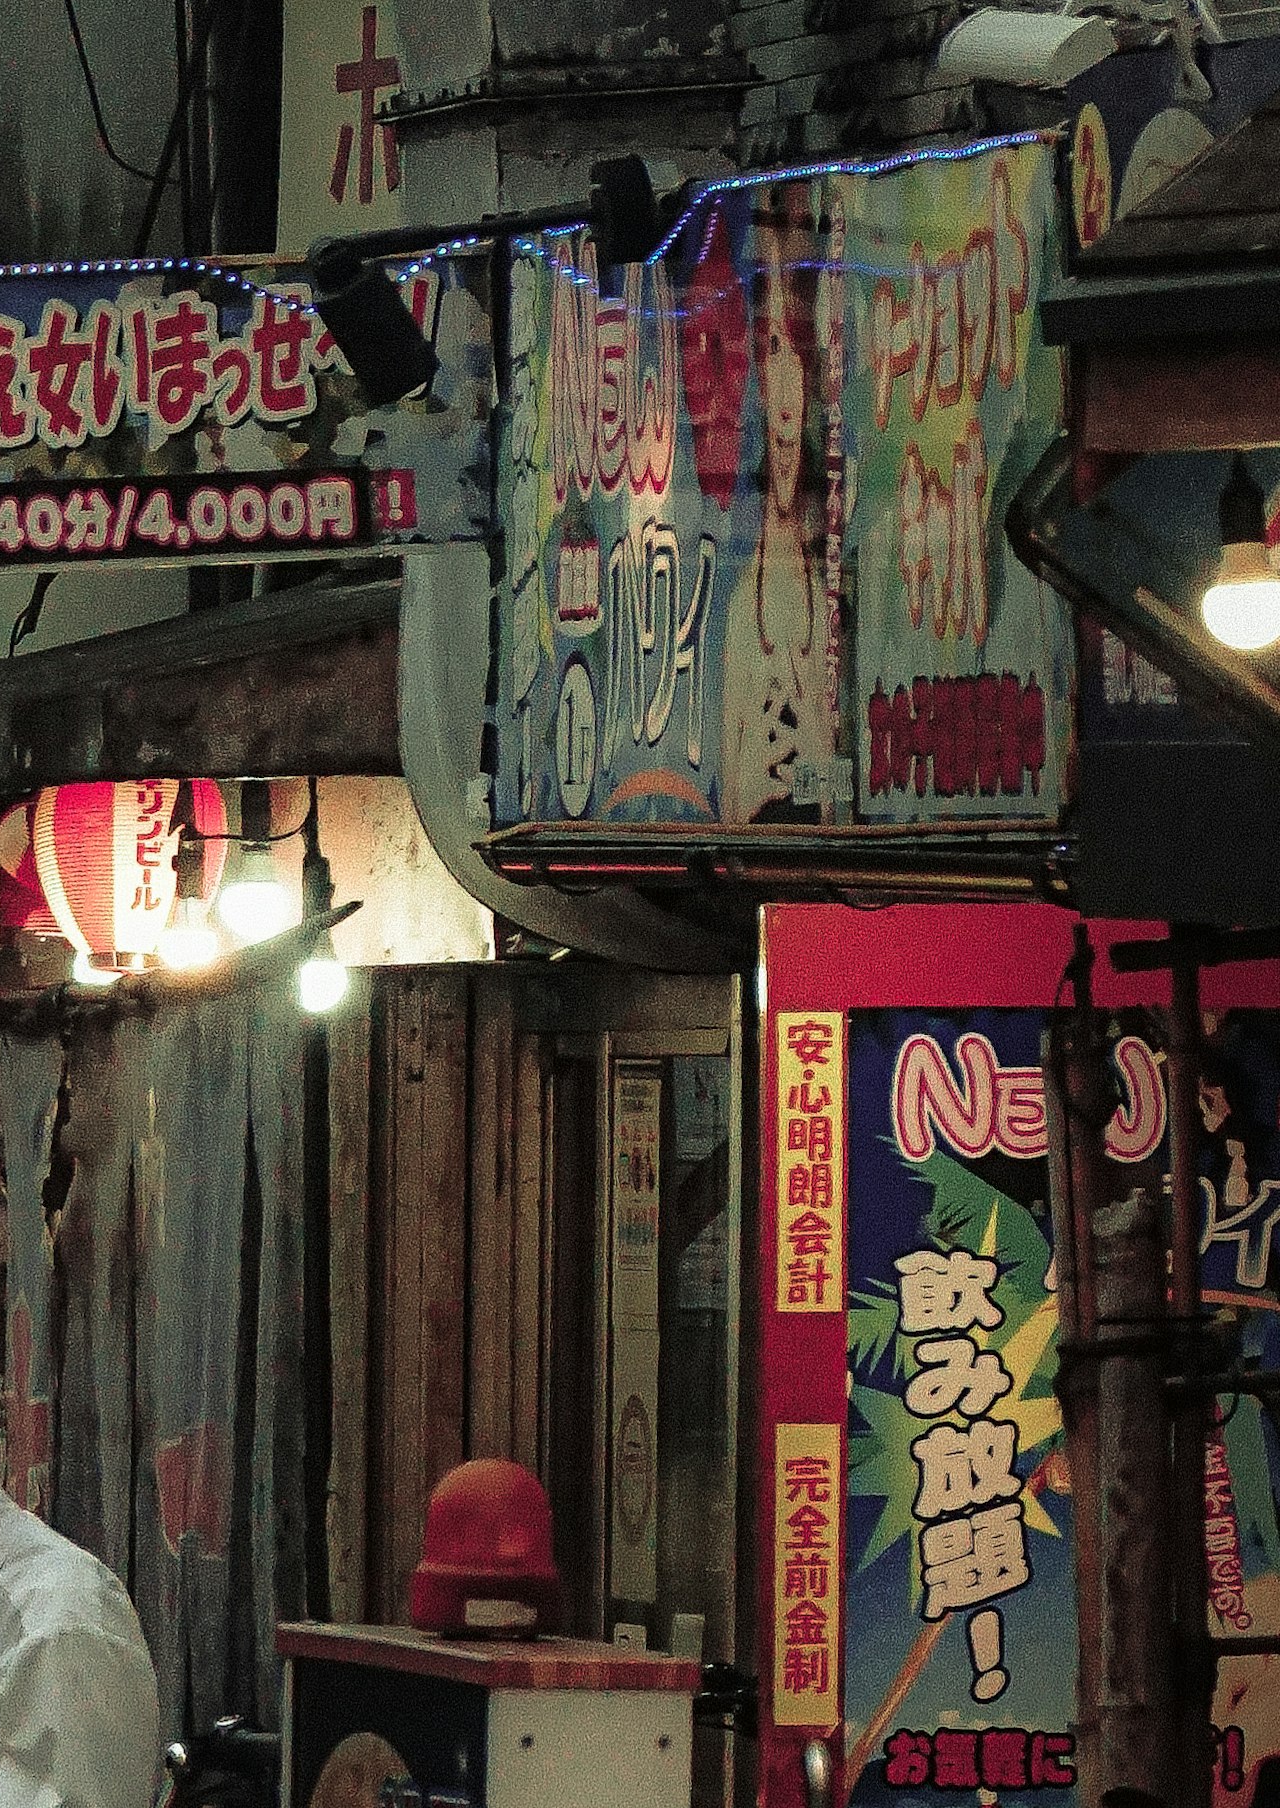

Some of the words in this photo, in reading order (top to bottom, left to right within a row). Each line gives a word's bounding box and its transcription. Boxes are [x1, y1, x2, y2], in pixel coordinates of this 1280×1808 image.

[548, 228, 678, 503] NEW
[564, 690, 592, 785] 1F
[787, 1020, 833, 1305] 安心明朗会計
[782, 1455, 836, 1696] 完全前金制
[896, 1249, 1032, 1704] 飲み放題!
